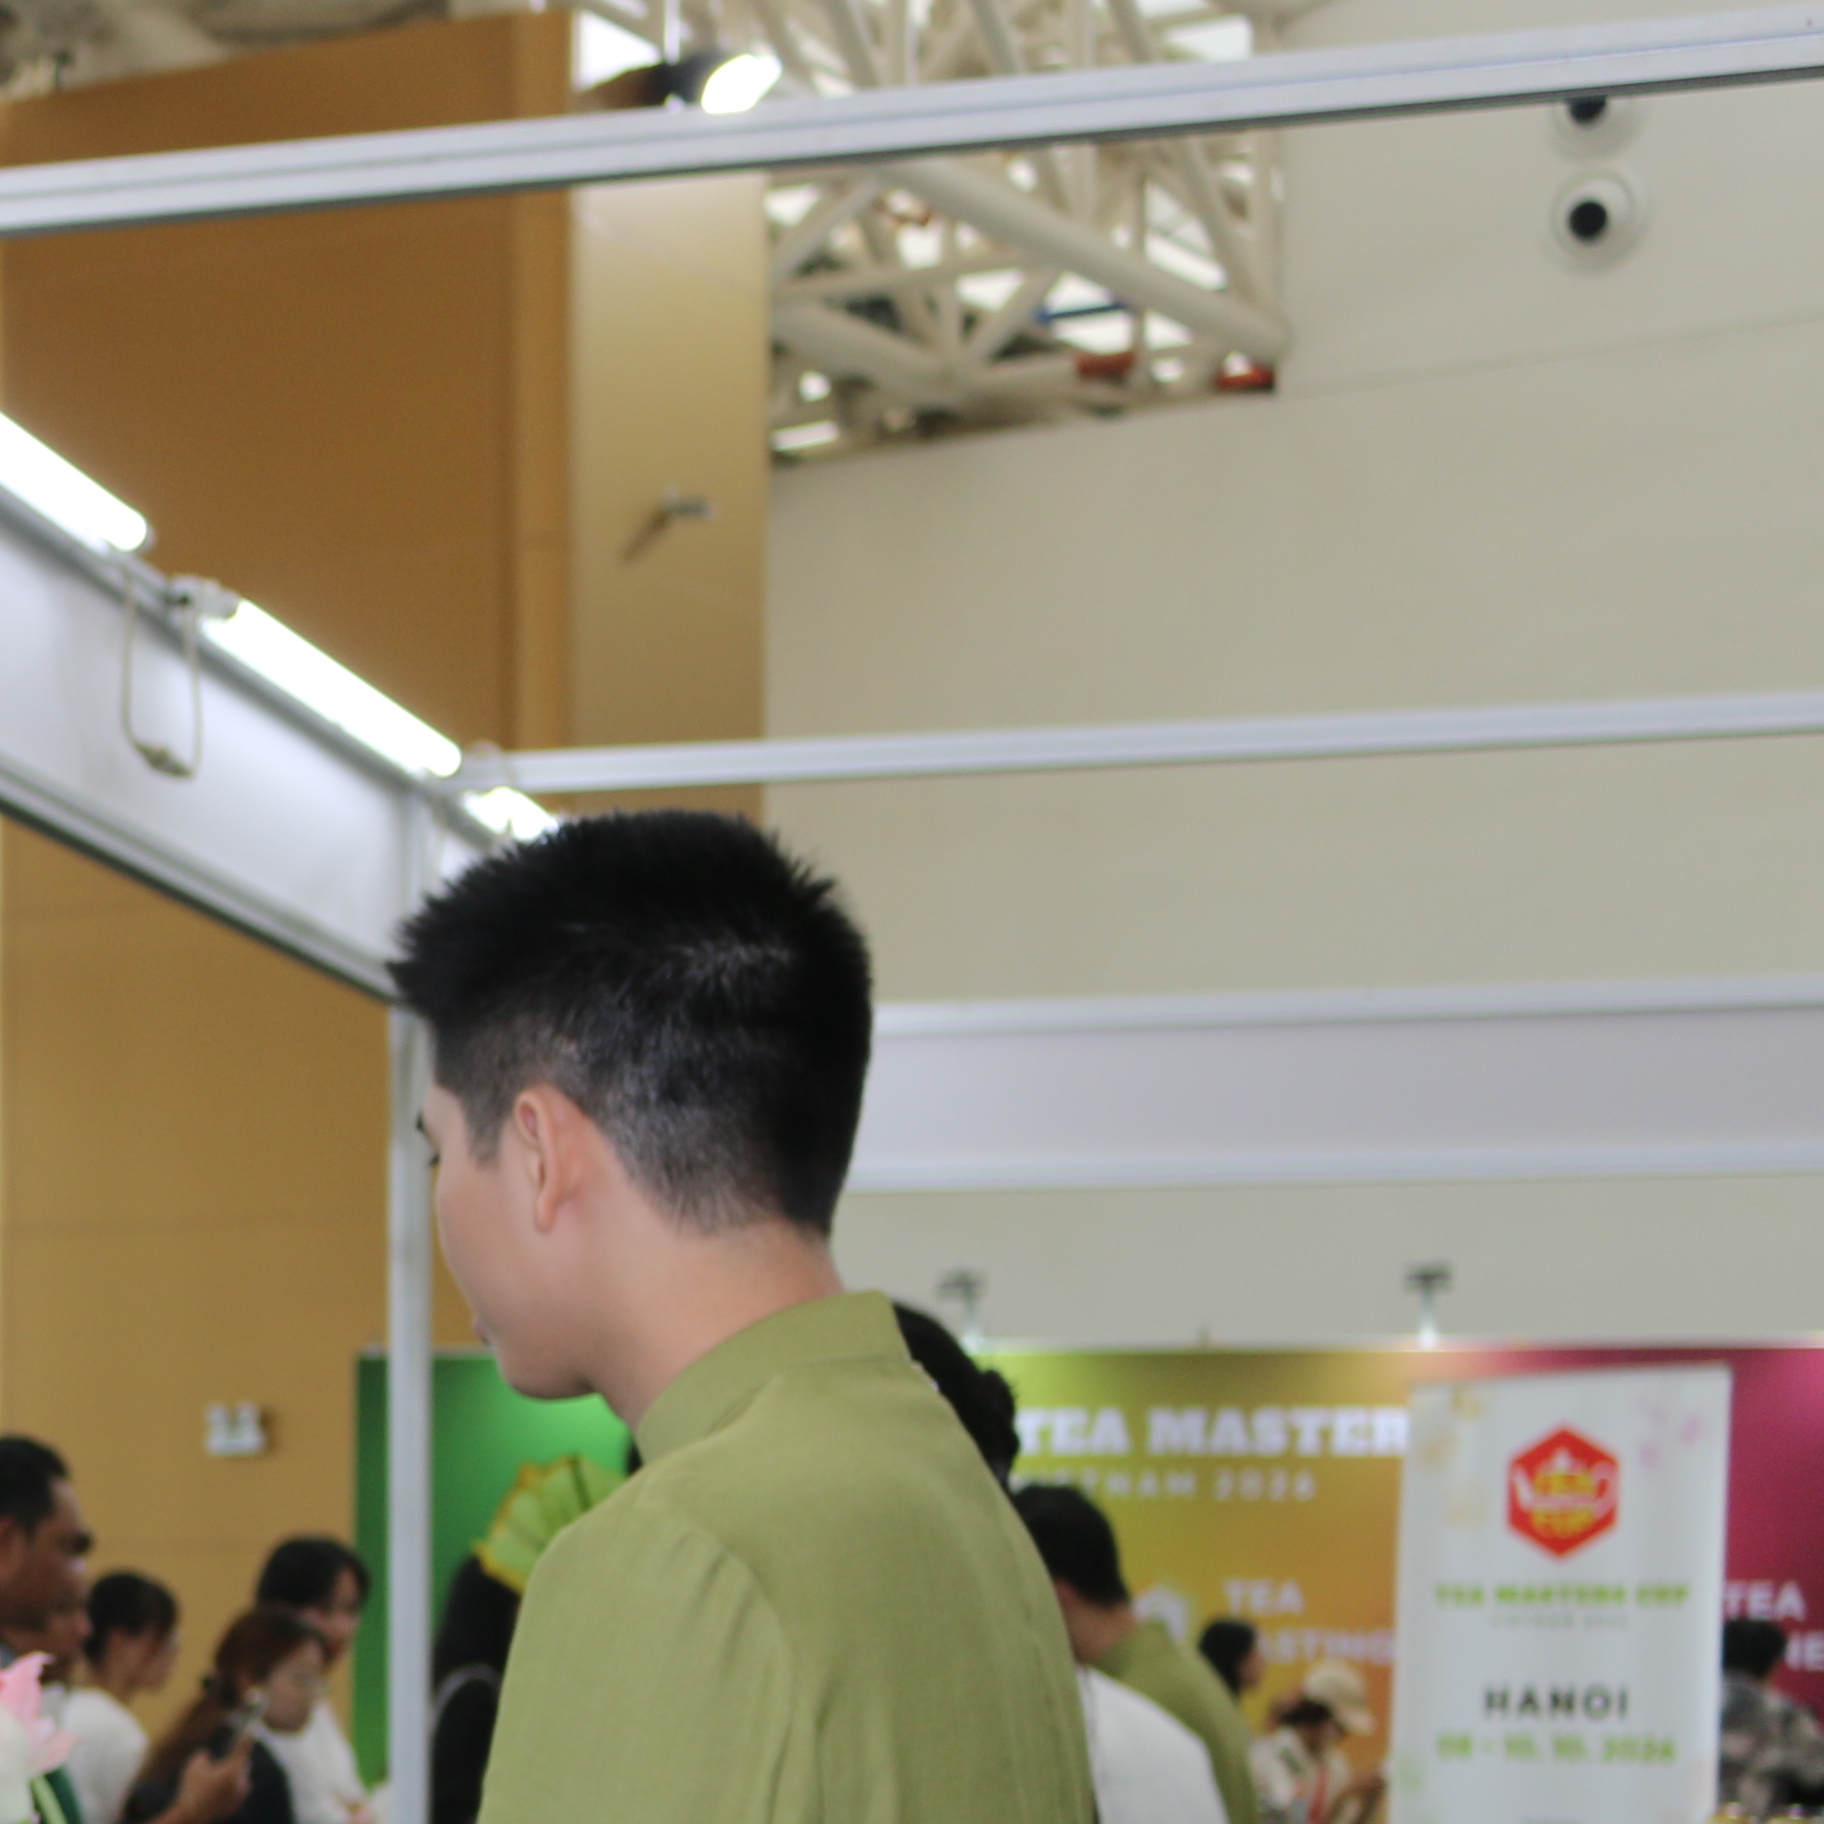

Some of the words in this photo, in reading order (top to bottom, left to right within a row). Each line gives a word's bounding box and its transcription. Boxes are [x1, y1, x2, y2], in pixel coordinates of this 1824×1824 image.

[1016, 1406, 1131, 1456] TEA
[1224, 1578, 1306, 1616] TEA
[1483, 1684, 1630, 1721] HANOI
